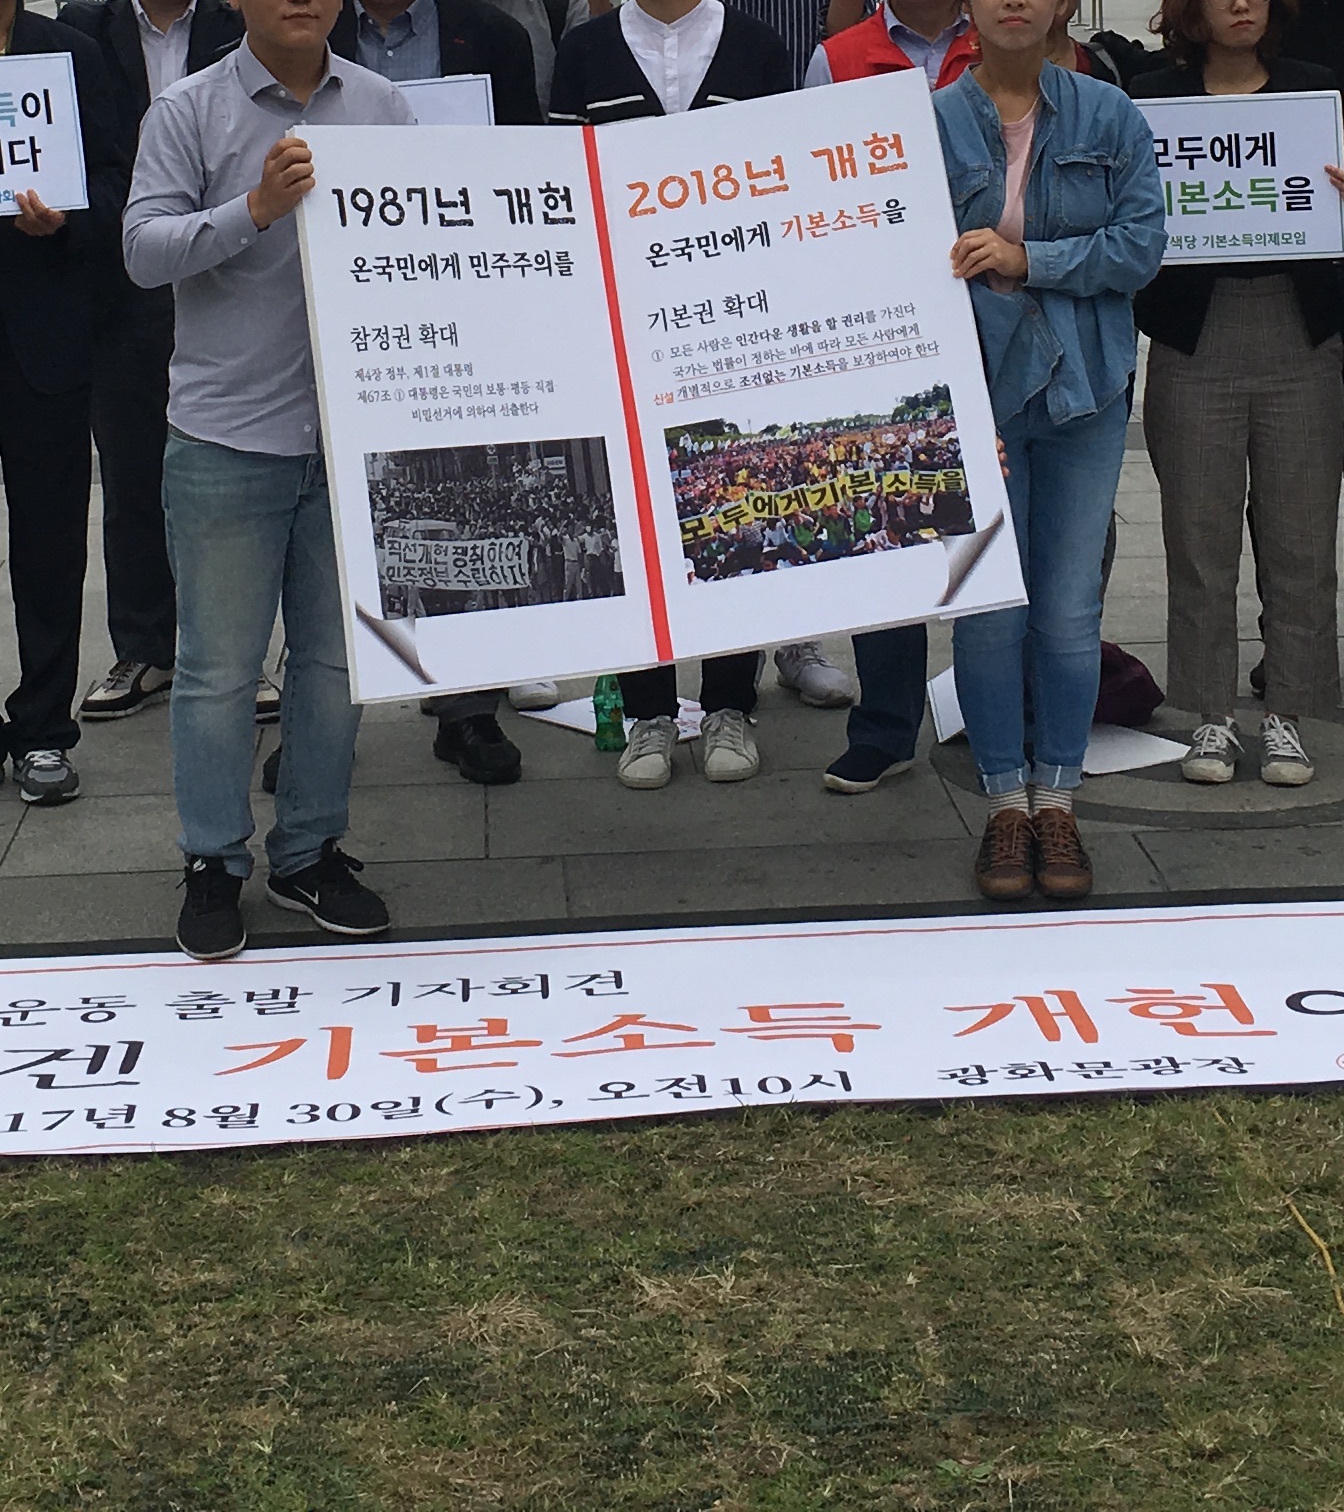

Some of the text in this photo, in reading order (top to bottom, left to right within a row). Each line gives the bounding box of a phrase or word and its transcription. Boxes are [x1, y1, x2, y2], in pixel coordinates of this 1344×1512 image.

[625, 131, 909, 219] 2018년 개헌
[332, 181, 576, 228] 1987년 개헌
[645, 198, 906, 267] 온국민에게 기본소득을
[1165, 231, 1307, 250] 색당 기본소득의제모임
[350, 250, 575, 283] 온국민에게 민주주의를
[648, 290, 769, 334] 기본권 확대
[669, 345, 693, 359] 모든
[697, 339, 733, 352] 사람은
[736, 328, 783, 347] 인간다운
[786, 320, 822, 337] 생활을
[825, 316, 837, 330] 할
[841, 310, 876, 327] 권리를
[880, 303, 916, 320] 가진다
[350, 322, 459, 352] 참정권 확대
[673, 322, 920, 378] 국가는 법률이 정하는 바에 따라 모든 사람에게
[355, 367, 382, 382] 제4장
[413, 364, 440, 379] 제1절
[443, 362, 474, 377] 대통령
[677, 340, 939, 400] 개별적으로 조건없는 기본소득을 보장하여야 한다
[357, 389, 392, 404] 제67조
[408, 386, 450, 401] 대통령은
[452, 383, 483, 398] 국민의
[653, 391, 674, 406] 신설
[387, 540, 448, 565] 직선개헌
[386, 564, 528, 587] 민주정부 수립하자
[165, 986, 313, 1021] 출발
[343, 970, 630, 1007] 기자회견
[213, 1002, 882, 1080] 기본소득
[161, 1103, 259, 1130] 8월
[285, 1084, 564, 1126] 30일(수),
[587, 1070, 854, 1101] 오전10시
[937, 1056, 1256, 1087] 광화문광장
